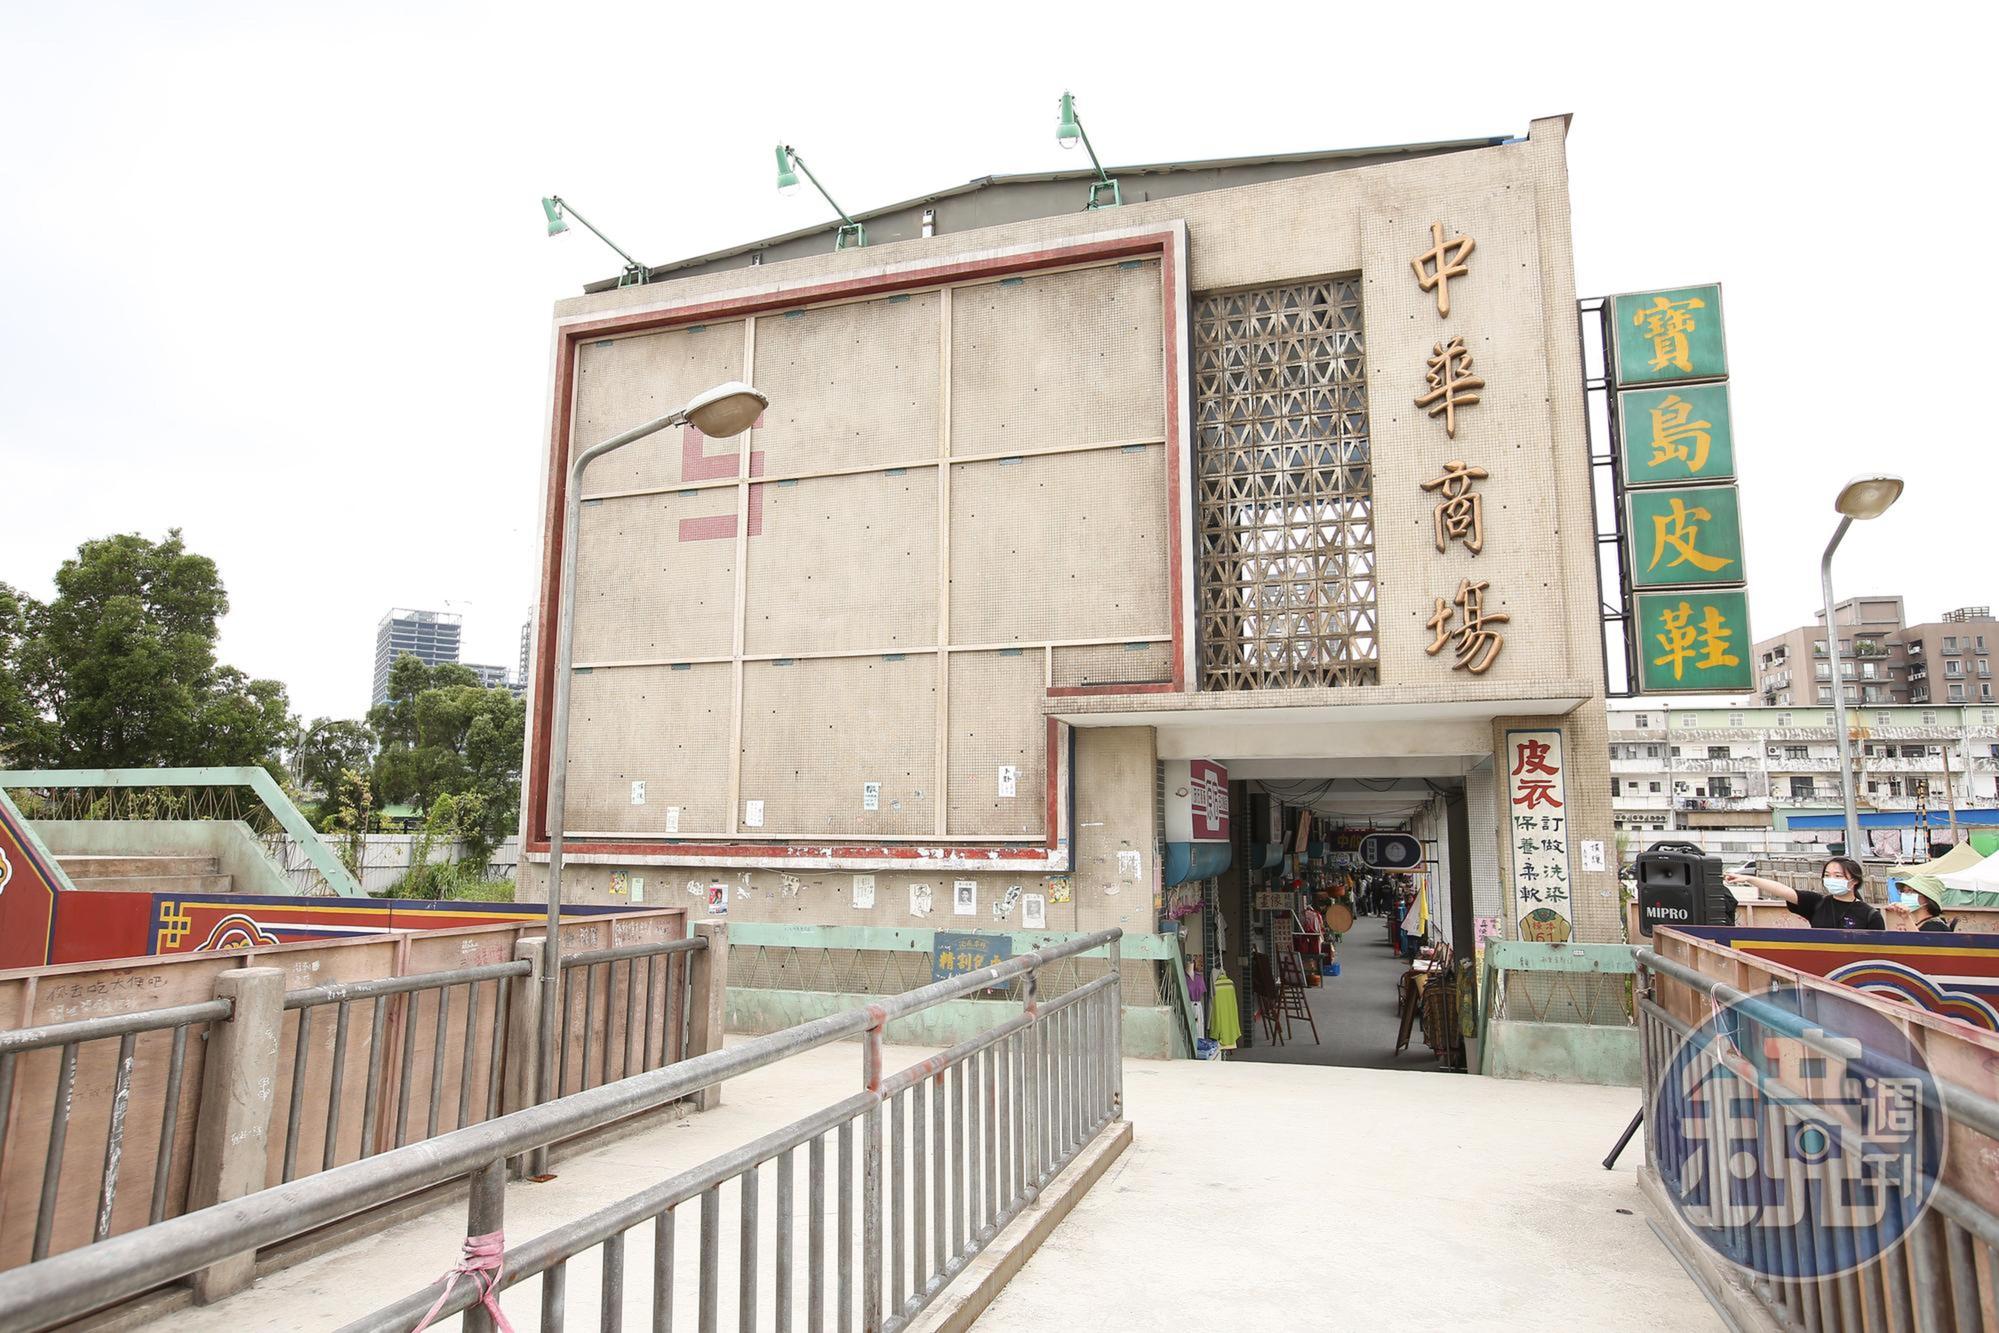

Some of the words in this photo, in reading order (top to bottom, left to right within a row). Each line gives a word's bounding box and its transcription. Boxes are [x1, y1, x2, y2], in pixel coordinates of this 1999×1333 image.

[1410, 219, 1510, 676] 中華商場
[1633, 297, 1740, 681] 寶島皮鞋
[1512, 739, 1564, 810] 皮衣
